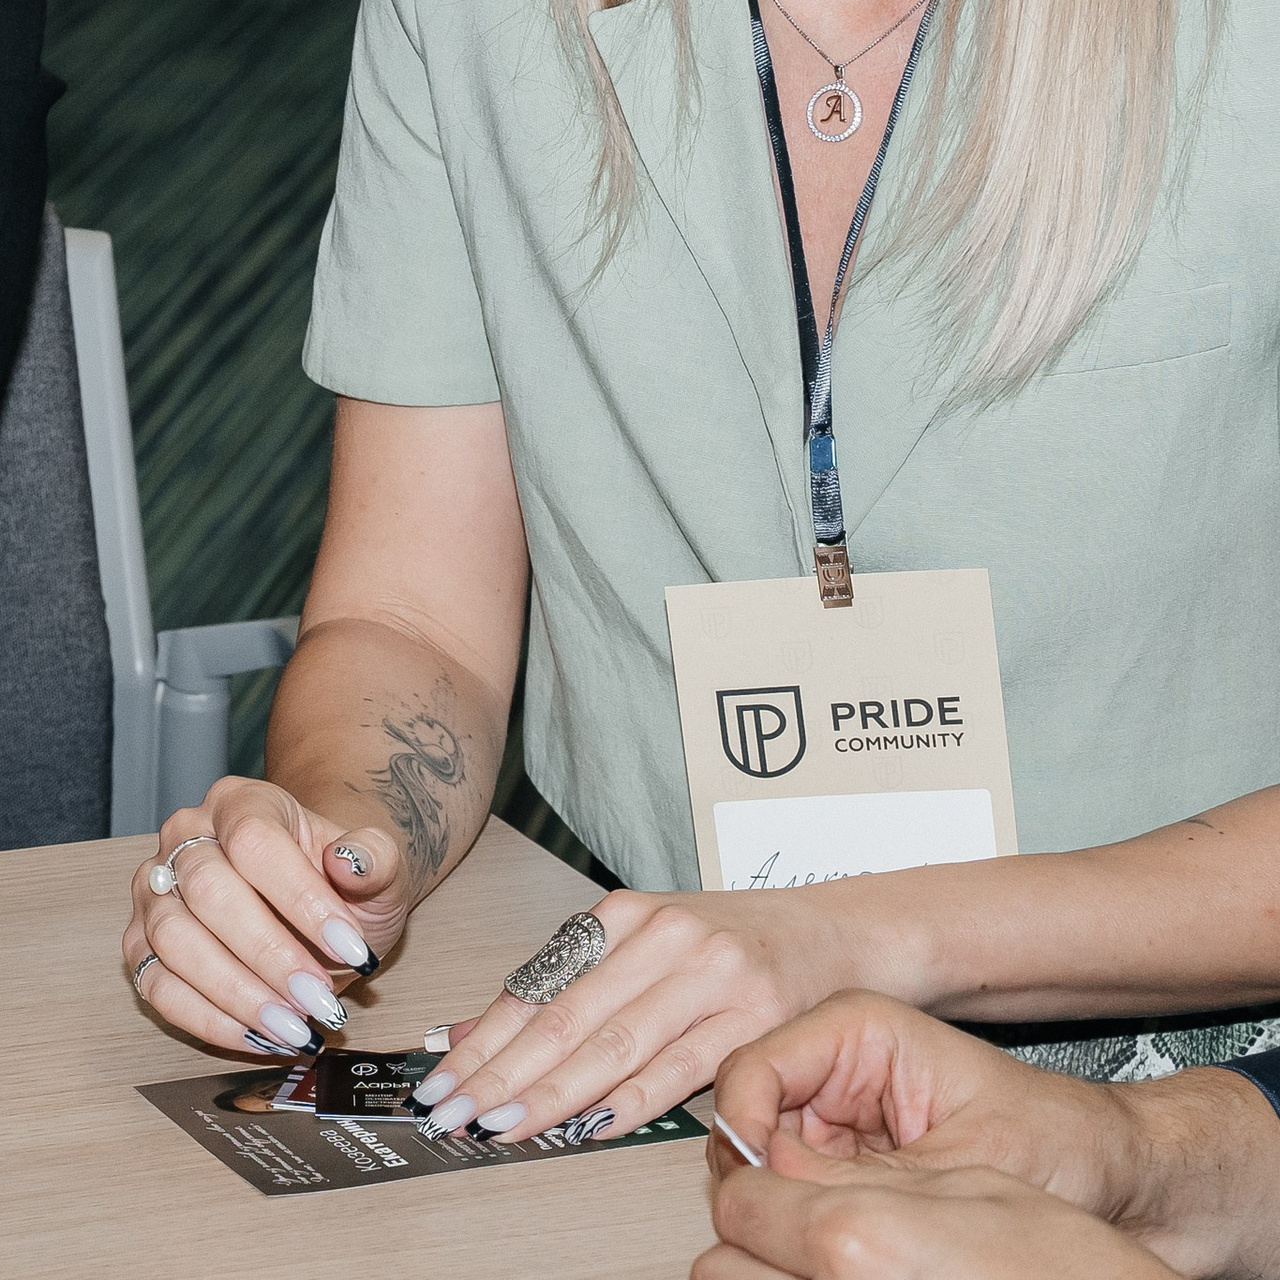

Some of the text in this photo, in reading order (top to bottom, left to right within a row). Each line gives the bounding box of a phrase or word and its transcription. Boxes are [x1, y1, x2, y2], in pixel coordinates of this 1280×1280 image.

[830, 696, 964, 732] PRIDE
[834, 732, 965, 753] COMMUNITY
[353, 1081, 411, 1090] Дарья
[319, 1130, 382, 1172] Козеева
[336, 1120, 409, 1168] Екатерин
